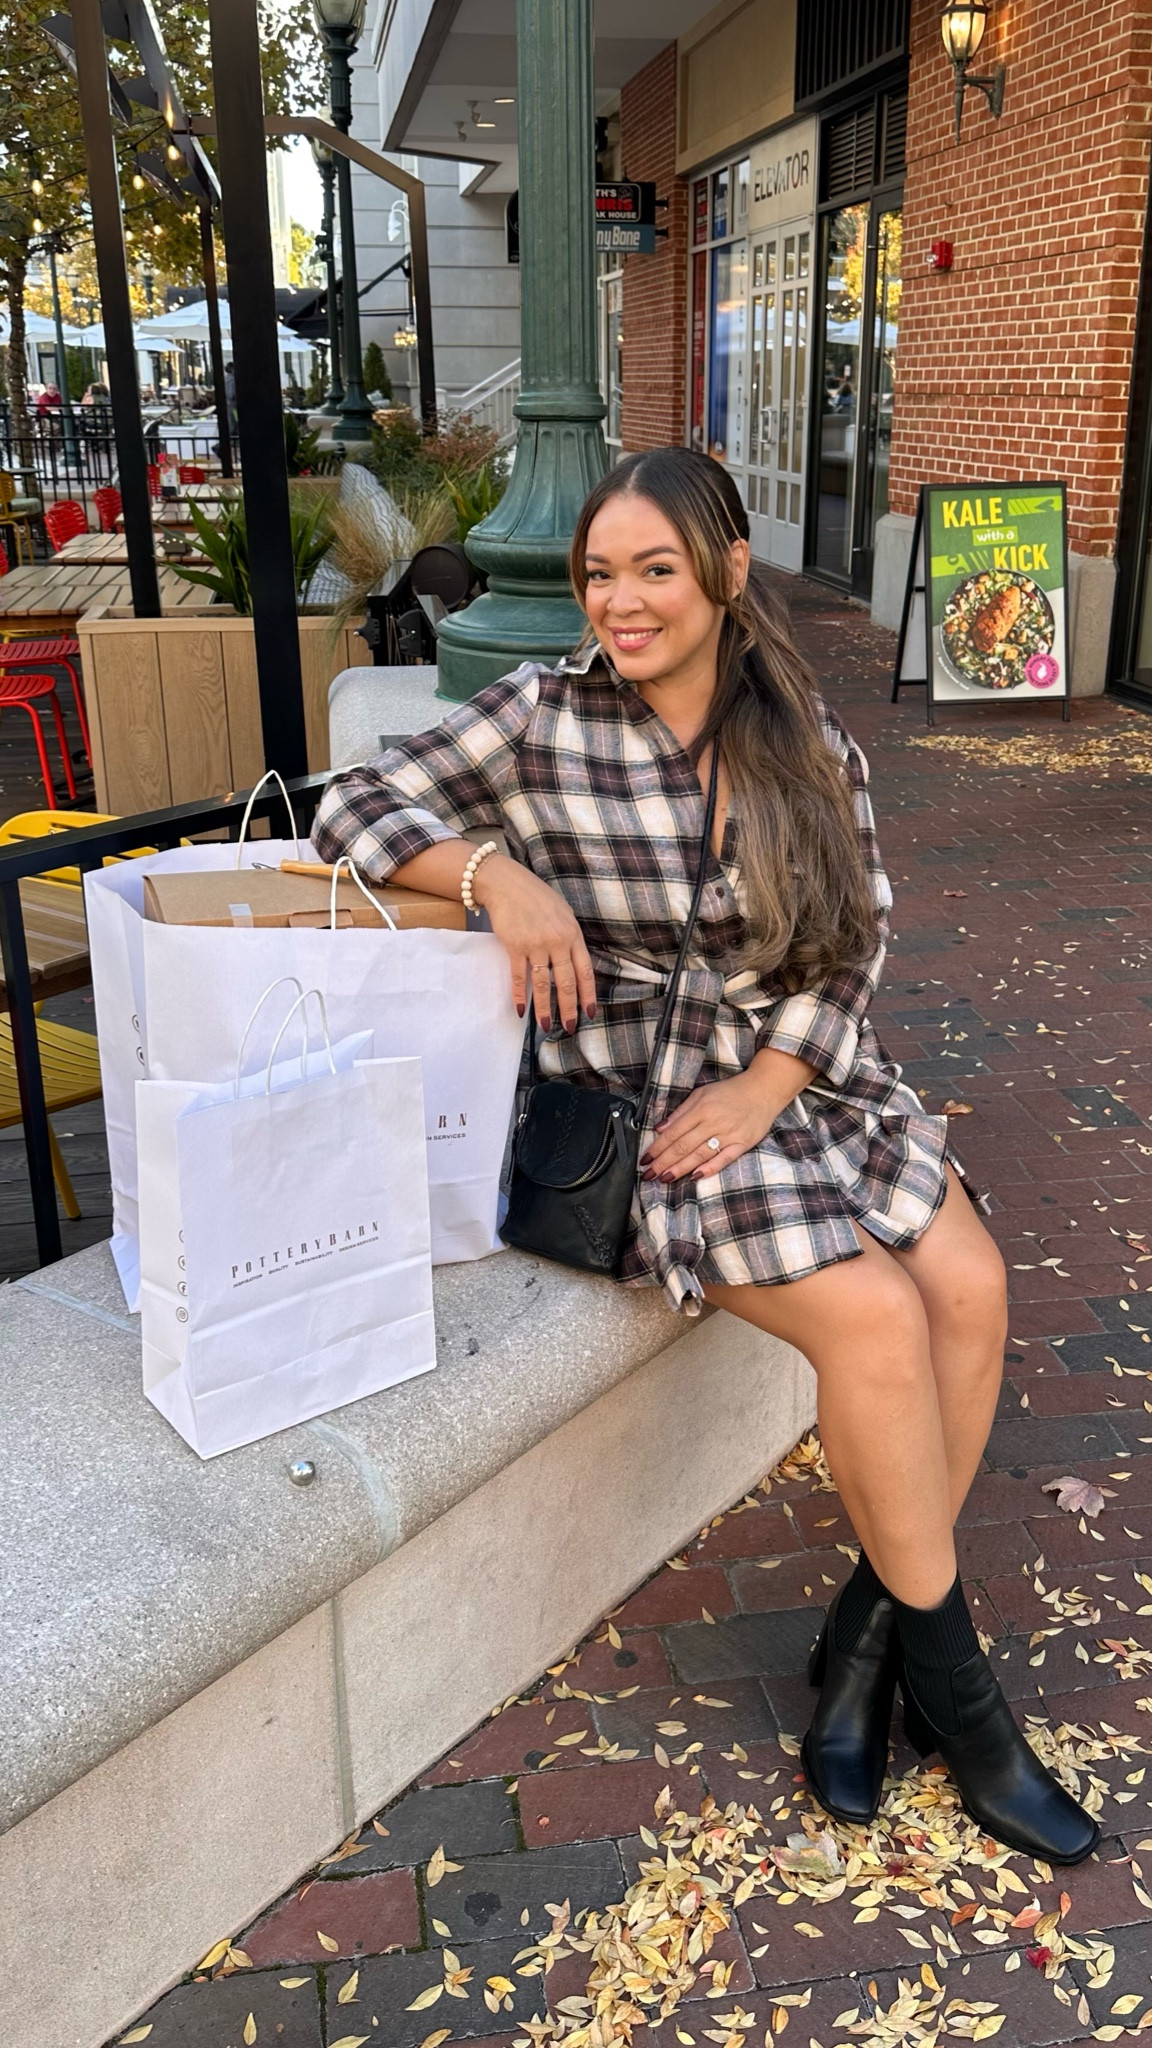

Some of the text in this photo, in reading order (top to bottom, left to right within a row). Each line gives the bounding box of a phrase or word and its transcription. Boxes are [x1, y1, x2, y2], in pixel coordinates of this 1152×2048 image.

[754, 149, 809, 203] ELEVATOR
[608, 211, 637, 219] HOUSE
[942, 497, 1003, 528] KALE
[976, 529, 1015, 542] with a
[993, 543, 1050, 572] KICK
[433, 1132, 466, 1141] SERVICES
